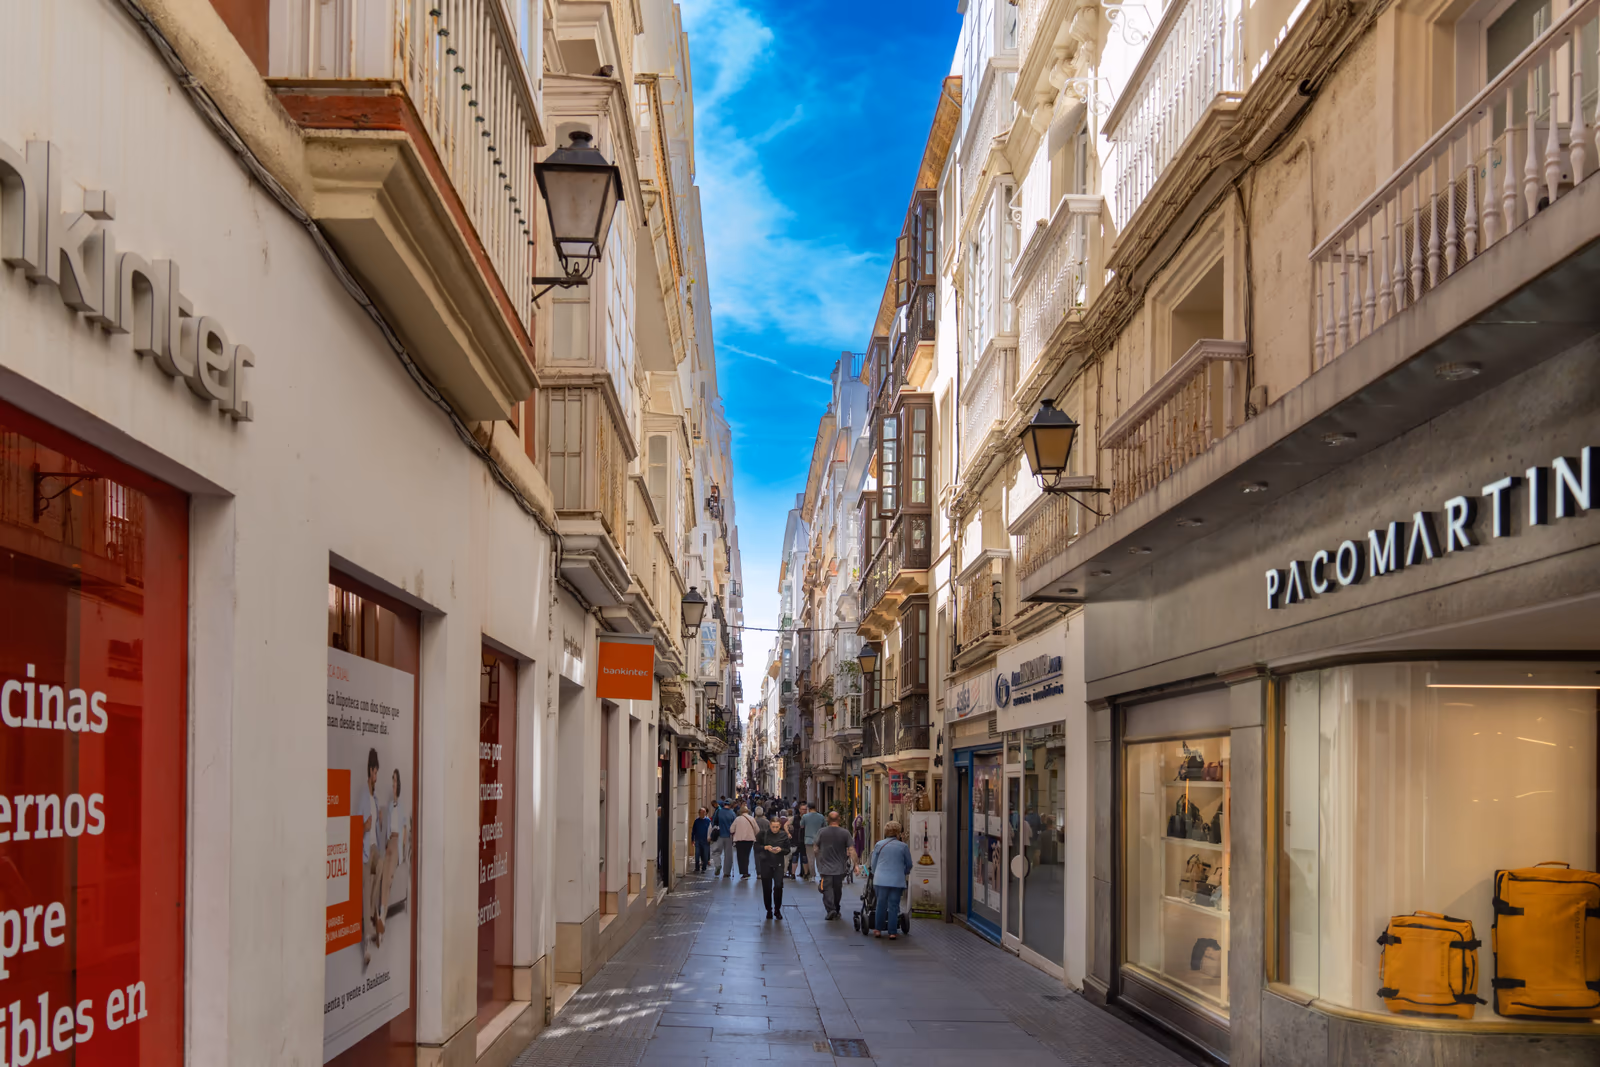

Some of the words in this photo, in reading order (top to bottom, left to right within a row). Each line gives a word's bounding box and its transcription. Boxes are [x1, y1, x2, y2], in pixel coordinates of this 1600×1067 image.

[1265, 445, 1595, 609] PACOMARTIN
[603, 666, 648, 677] bankinter
[1, 663, 108, 733] cinas
[370, 698, 378, 713] dos
[492, 743, 503, 768] por
[480, 779, 503, 801] cuentas
[482, 815, 503, 849] quedas
[106, 979, 148, 1031] en
